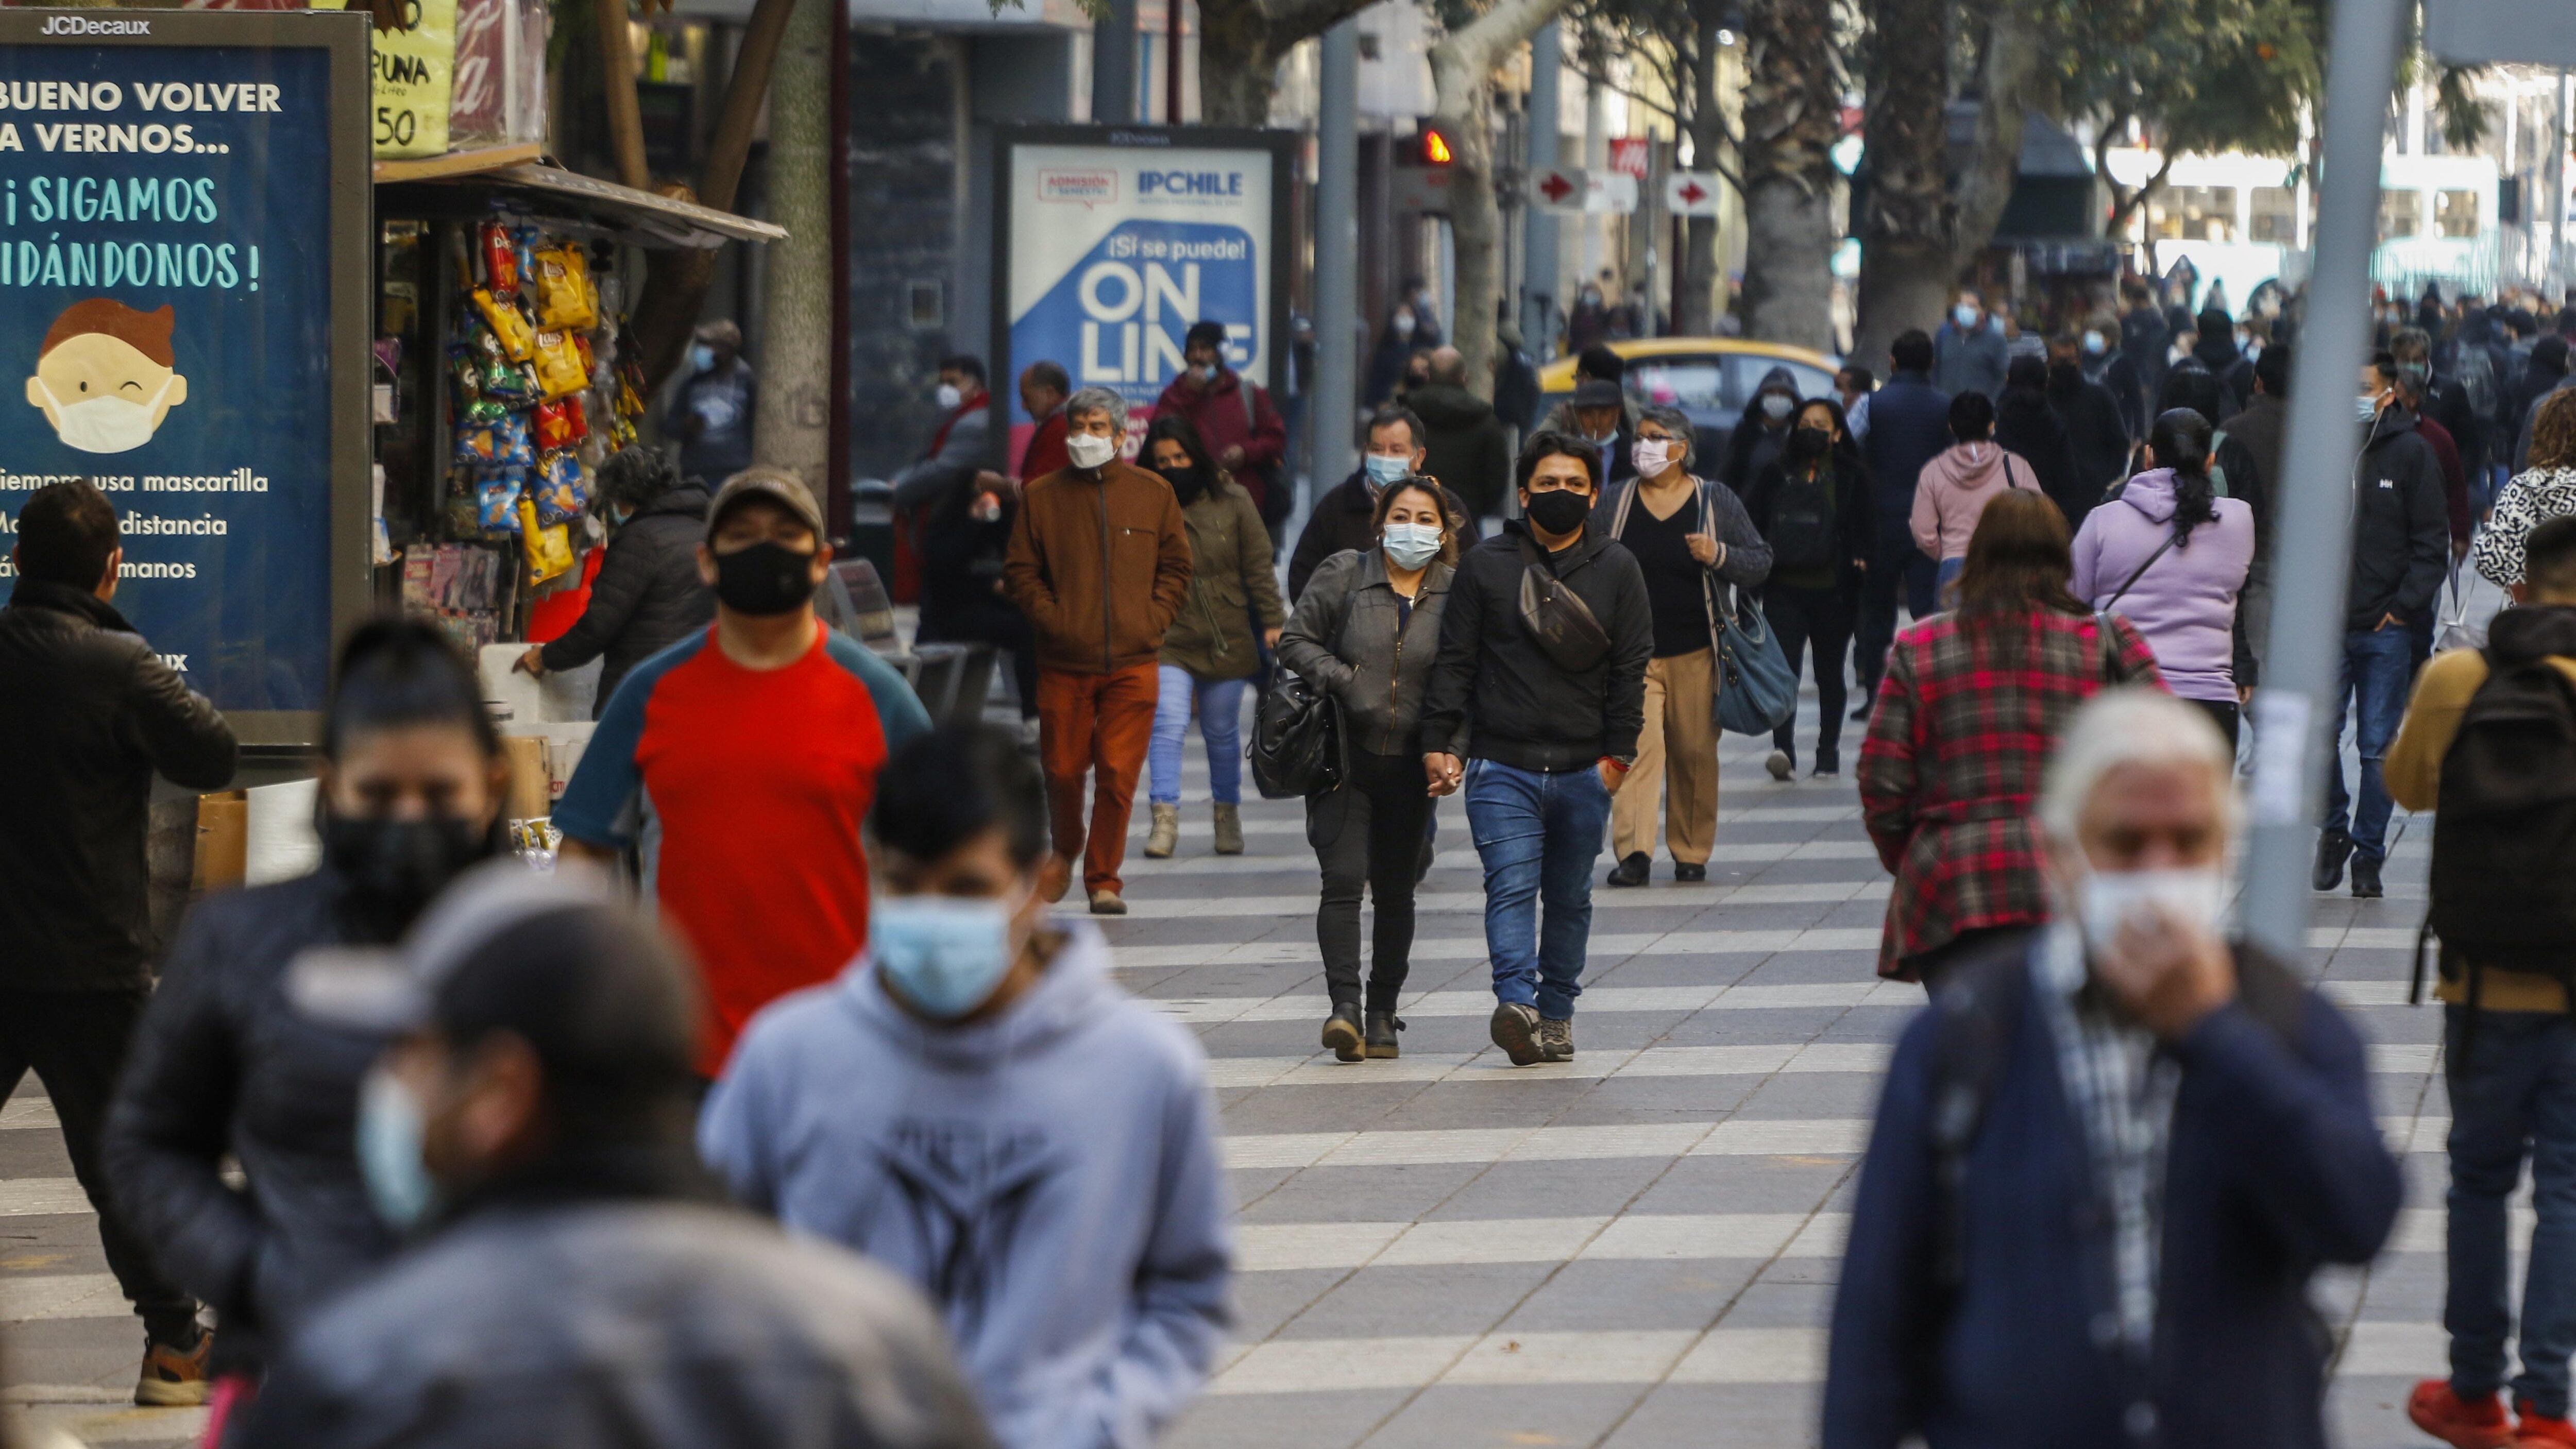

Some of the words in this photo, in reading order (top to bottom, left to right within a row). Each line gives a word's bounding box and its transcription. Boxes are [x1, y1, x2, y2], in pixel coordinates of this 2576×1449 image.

[41, 16, 150, 35] JCDecaux
[134, 82, 283, 112] VOLVER
[0, 123, 25, 151] A
[34, 123, 230, 154] VERNOS...
[1138, 171, 1242, 195] IPCHILE
[1142, 241, 1167, 258] se
[1172, 238, 1246, 263] puede!
[1080, 261, 1200, 323] ON
[93, 475, 135, 491] usa
[143, 468, 268, 492] mascarilla
[119, 510, 227, 535] distancia
[117, 561, 197, 578] manos
